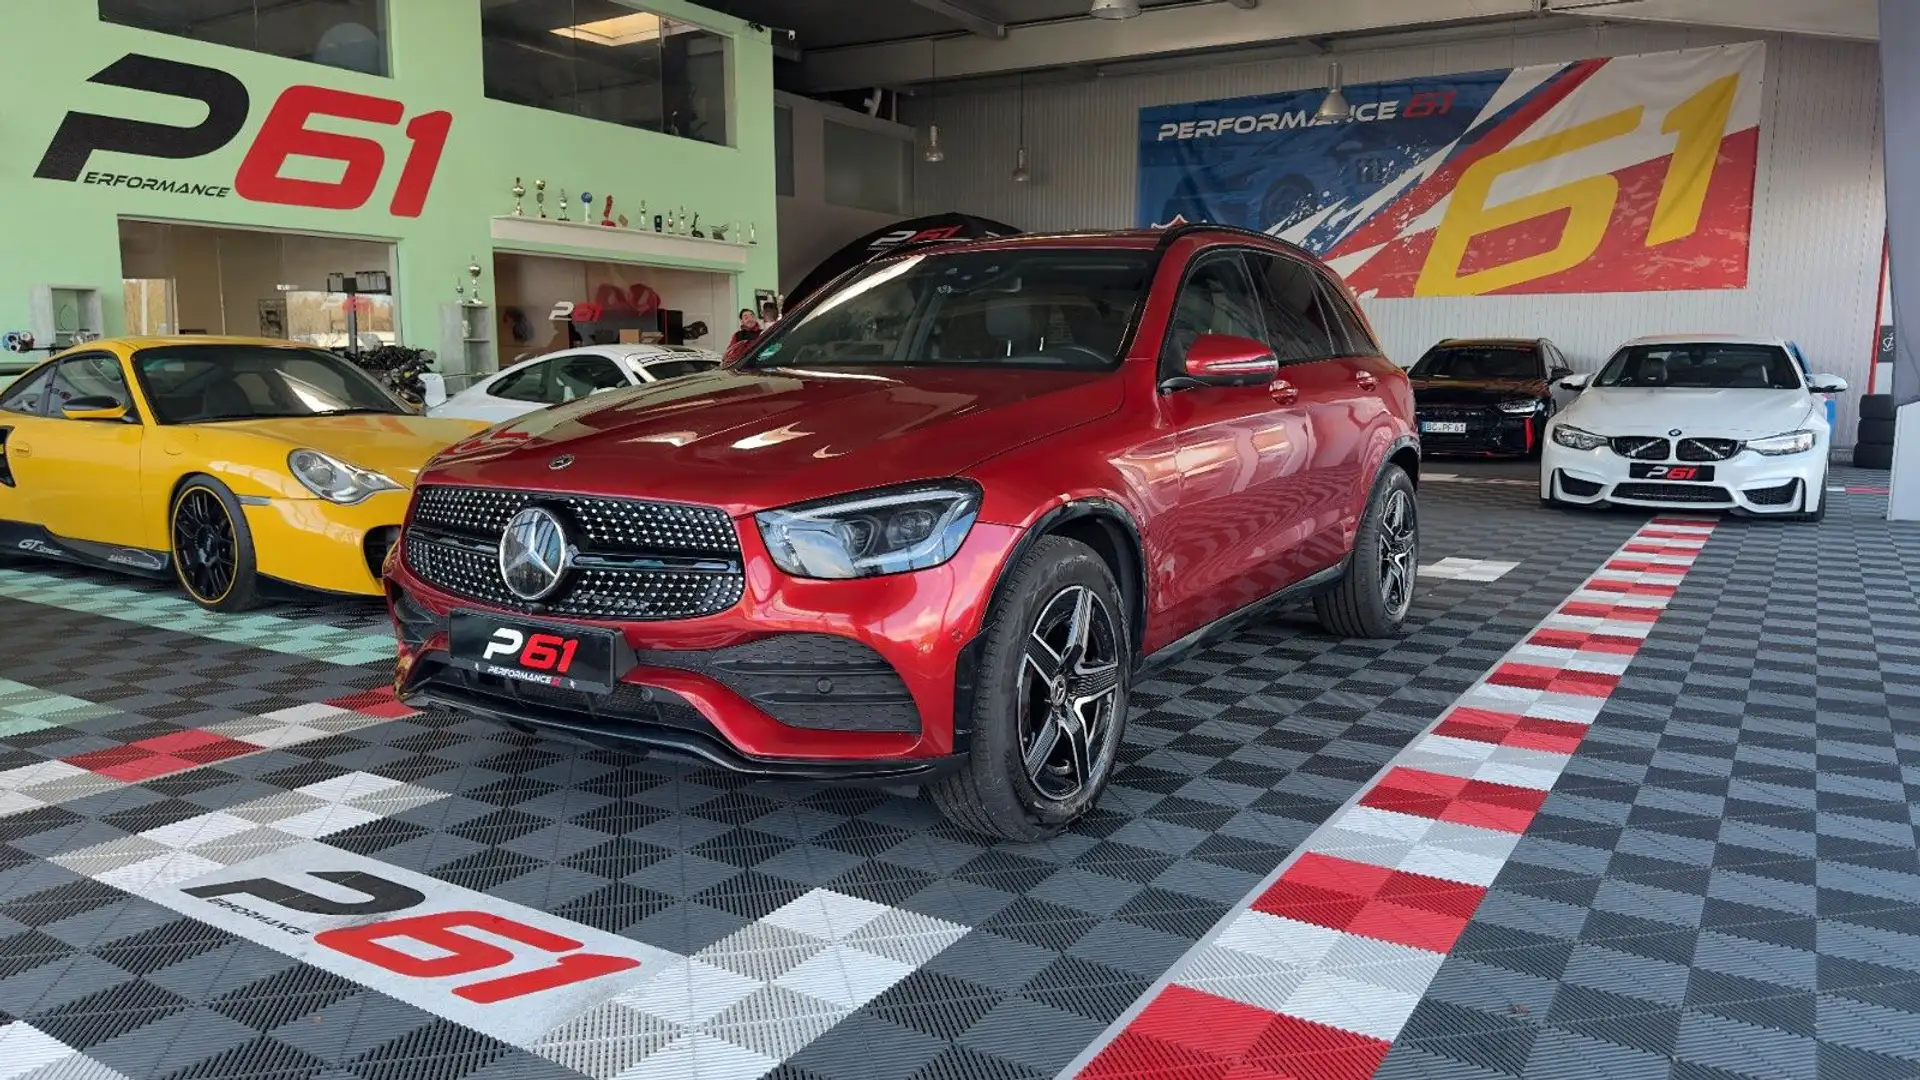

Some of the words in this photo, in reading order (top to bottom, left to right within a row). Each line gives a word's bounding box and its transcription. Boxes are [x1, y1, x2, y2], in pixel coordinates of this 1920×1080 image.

[1405, 93, 1456, 118] 61
[33, 53, 452, 217] P61
[83, 171, 230, 198] ERFORMANCE
[1415, 74, 1740, 298] 61
[1646, 466, 1697, 480] P61
[483, 628, 579, 673] P61
[487, 665, 552, 684] PERFORMANCE
[180, 870, 641, 1003] P61
